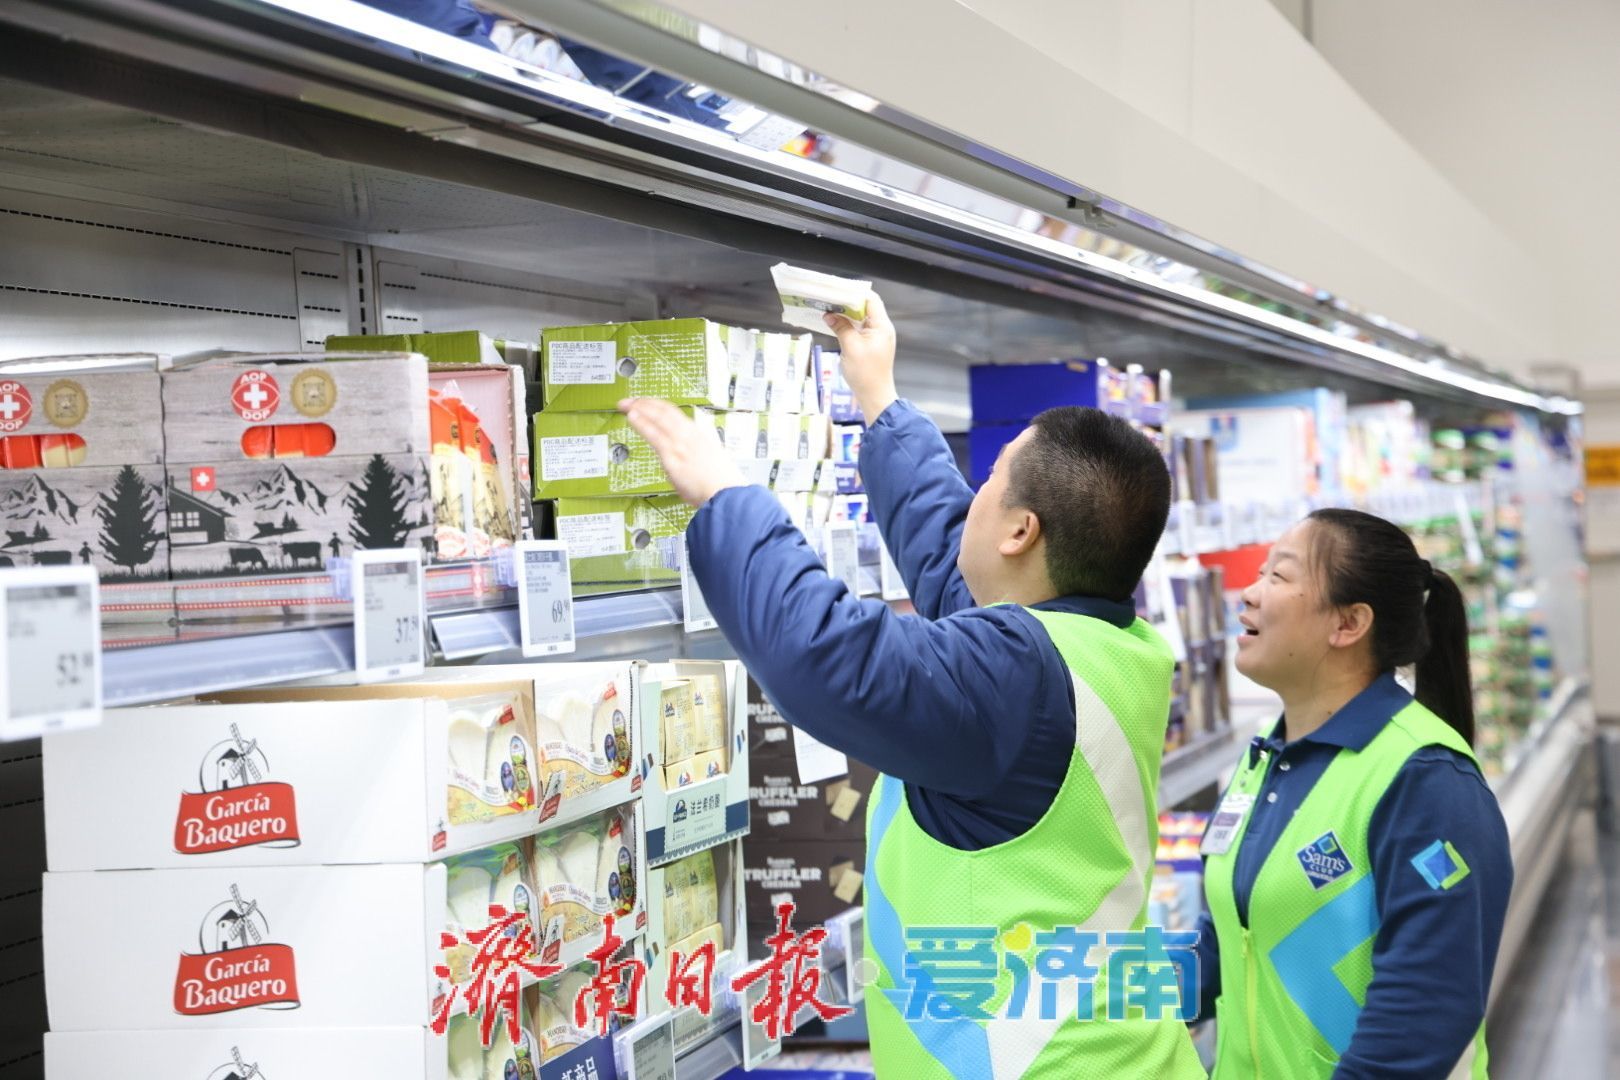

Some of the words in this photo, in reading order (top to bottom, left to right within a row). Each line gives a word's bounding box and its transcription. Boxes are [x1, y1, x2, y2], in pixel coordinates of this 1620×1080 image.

[241, 372, 267, 385] AOP
[242, 409, 270, 420] DOP
[205, 792, 271, 821] García
[749, 786, 819, 799] RUFFLER
[183, 816, 287, 848] Baquero
[1301, 845, 1346, 872] Sam's
[204, 953, 271, 982] García
[182, 977, 287, 1009] Baquero
